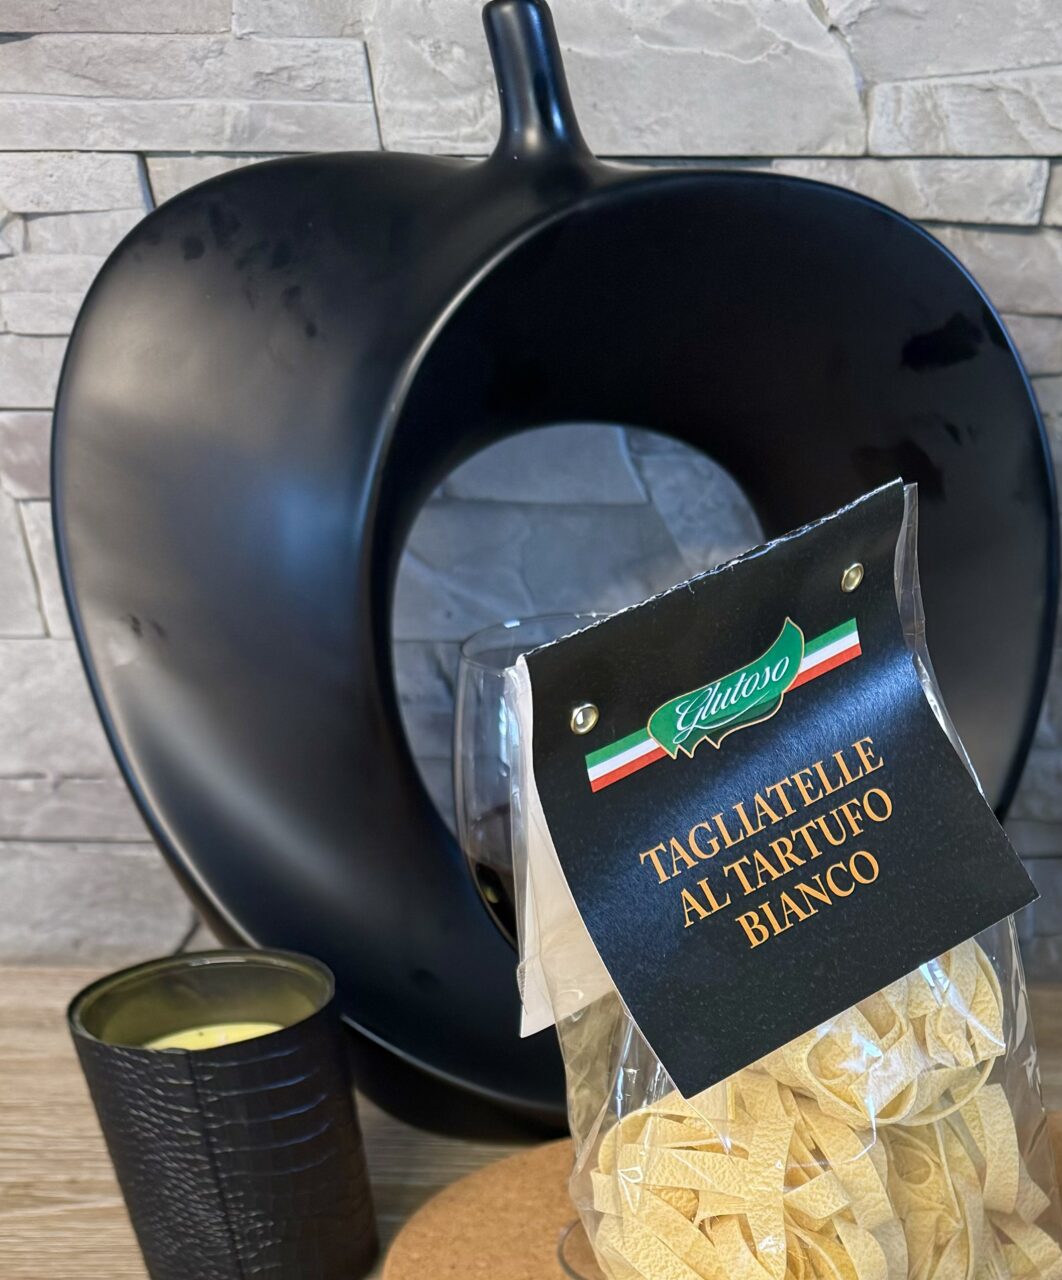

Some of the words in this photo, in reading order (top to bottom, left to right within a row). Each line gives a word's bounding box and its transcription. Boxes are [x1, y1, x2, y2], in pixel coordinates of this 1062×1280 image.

[673, 656, 790, 744] Glutoso
[639, 736, 884, 885] TAGLIATELLE
[679, 877, 732, 928] AL
[723, 788, 893, 896] TARTUFO
[735, 850, 880, 949] BIANCO
